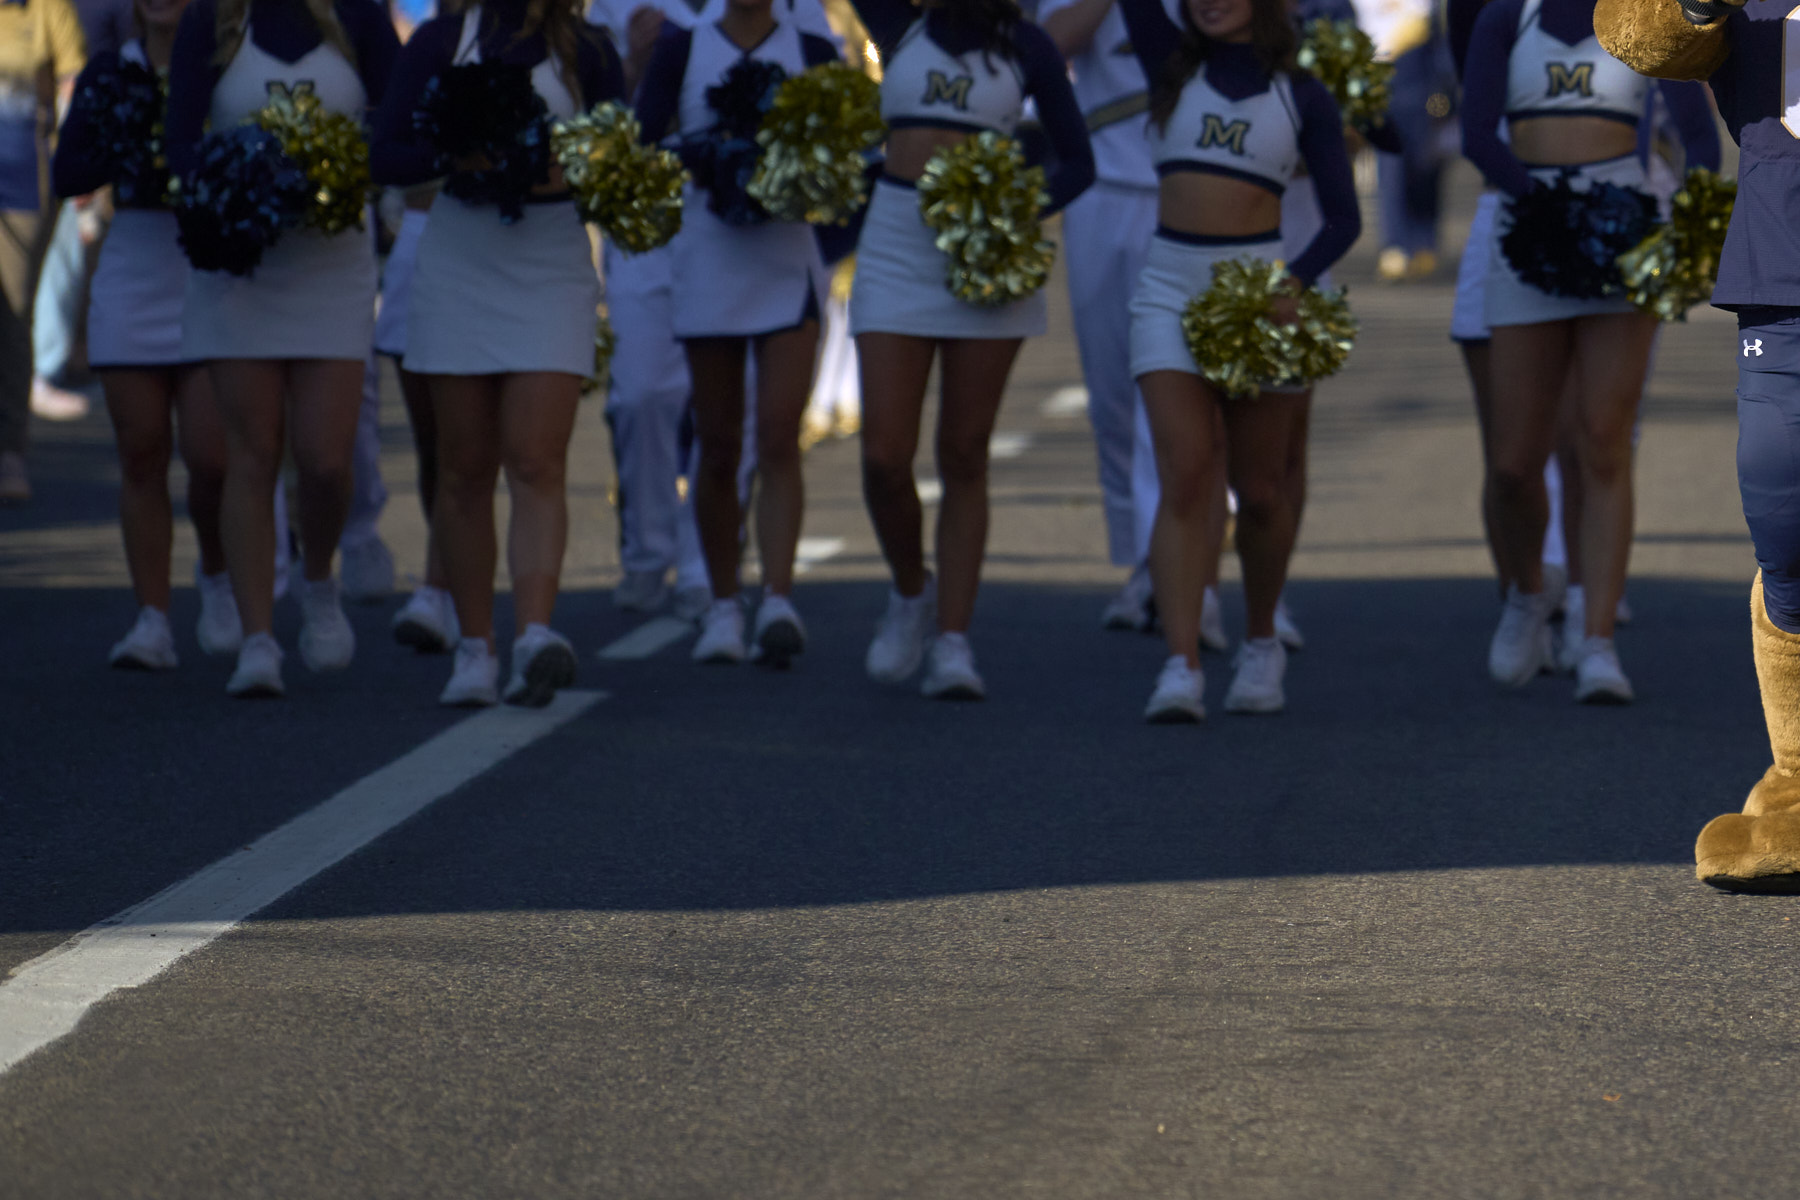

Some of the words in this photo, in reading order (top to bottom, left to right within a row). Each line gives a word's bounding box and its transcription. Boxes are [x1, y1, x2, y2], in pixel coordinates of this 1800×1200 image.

[921, 70, 973, 111] M
[1546, 62, 1594, 98] M
[1196, 113, 1250, 155] M
